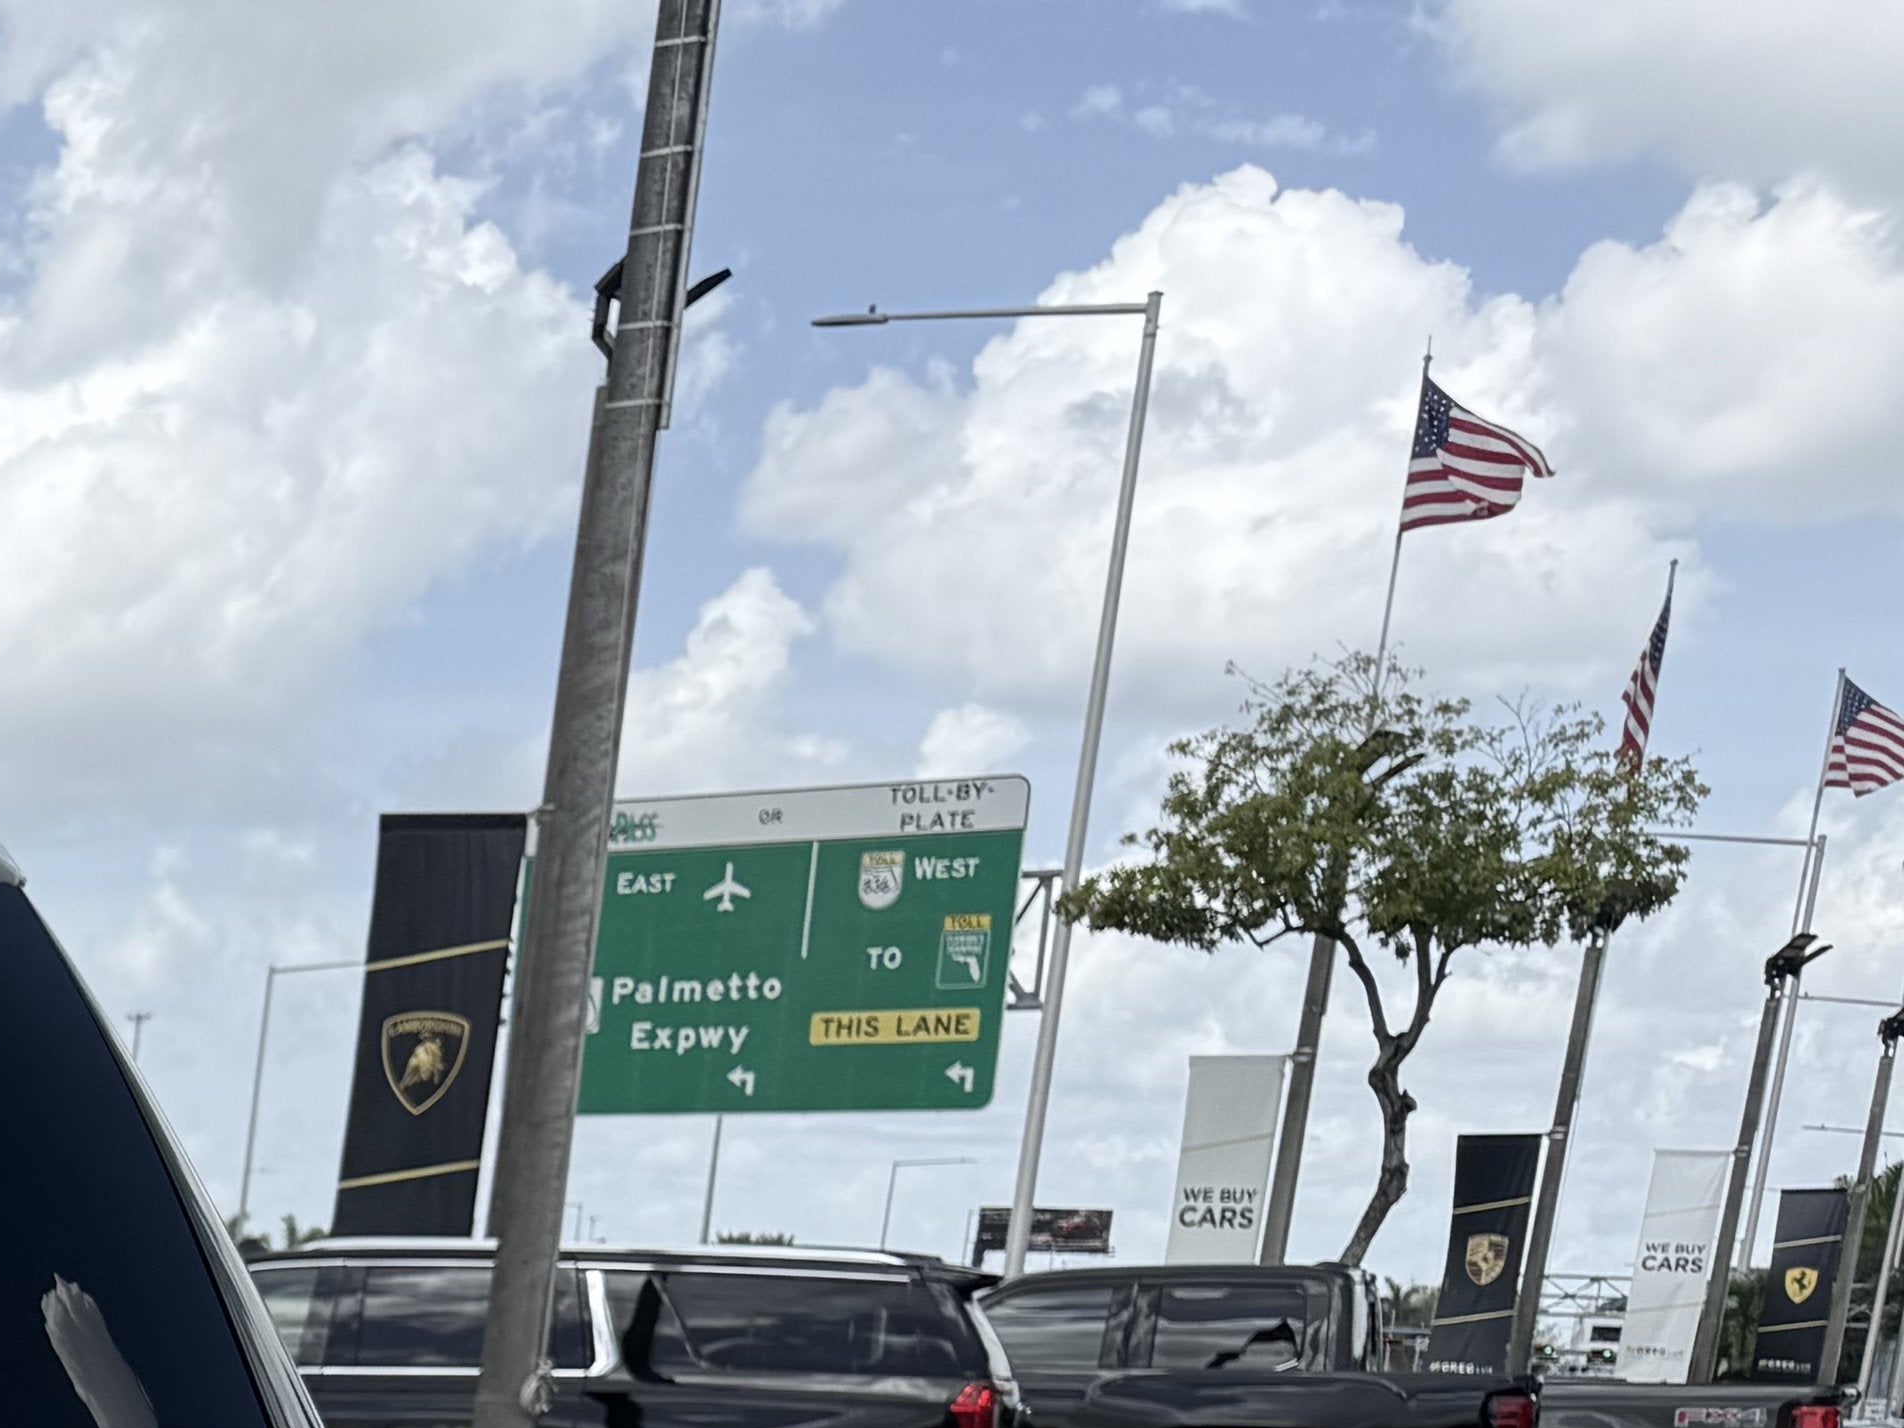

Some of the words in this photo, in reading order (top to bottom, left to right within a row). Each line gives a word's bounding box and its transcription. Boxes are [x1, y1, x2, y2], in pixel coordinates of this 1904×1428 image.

[899, 810, 976, 832] PLATE
[914, 856, 980, 880] WEST
[616, 872, 677, 895] EAST
[866, 946, 902, 970] TO
[612, 971, 782, 1005] Palmetto
[630, 1021, 751, 1056] Expwy
[821, 1016, 880, 1041] THIS
[895, 1013, 972, 1037] LANE
[1183, 1186, 1215, 1203] WE
[1219, 1186, 1257, 1204] BUY
[1178, 1205, 1255, 1229] CARS
[1645, 1242, 1671, 1254] WE
[1674, 1243, 1707, 1256] BUY
[1641, 1255, 1704, 1274] CARS
